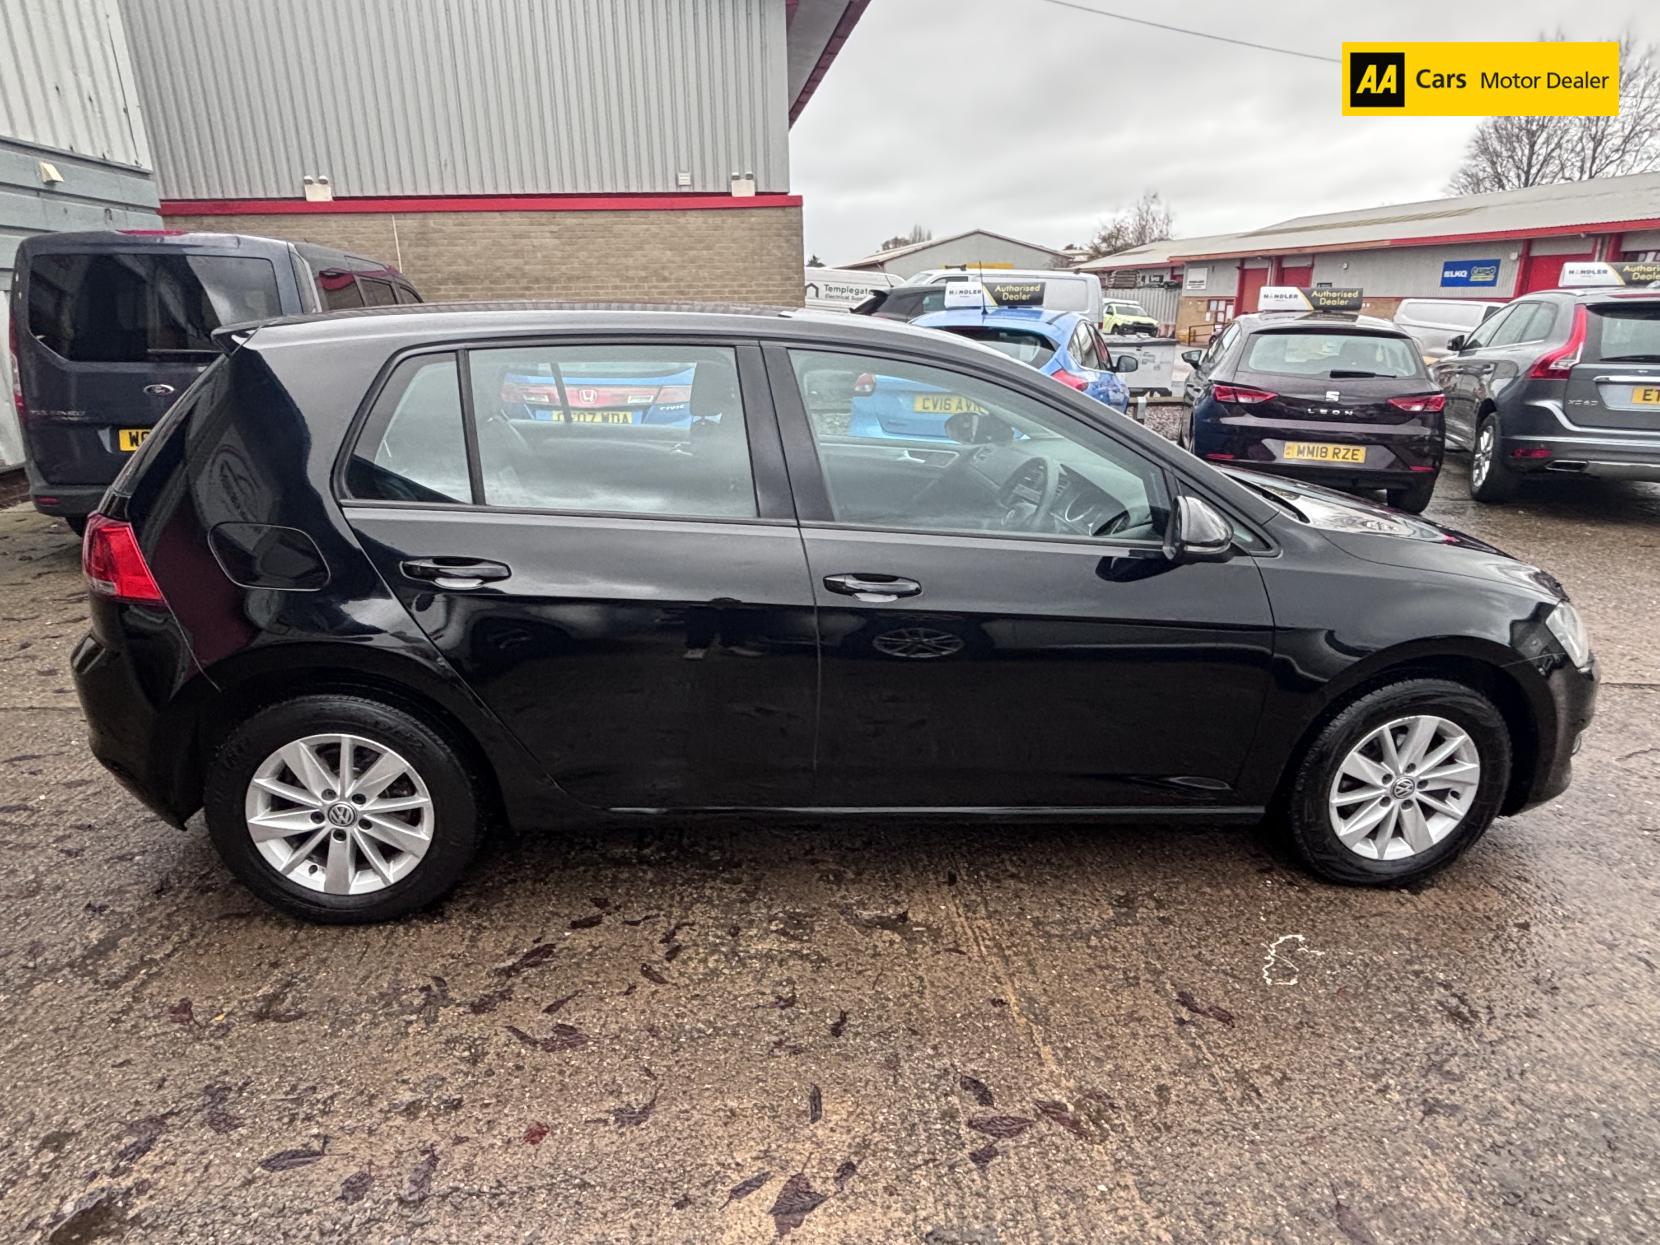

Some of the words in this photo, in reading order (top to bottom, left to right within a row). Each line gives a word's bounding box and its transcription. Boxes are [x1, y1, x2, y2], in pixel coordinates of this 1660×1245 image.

[995, 284, 1040, 293] Authorised
[1002, 292, 1031, 301] Dealer
[1311, 290, 1359, 298] Authorised
[1319, 298, 1349, 306] Dealer
[922, 397, 952, 411] CV16
[1296, 445, 1328, 458] MM18
[1332, 447, 1361, 461] RZE
